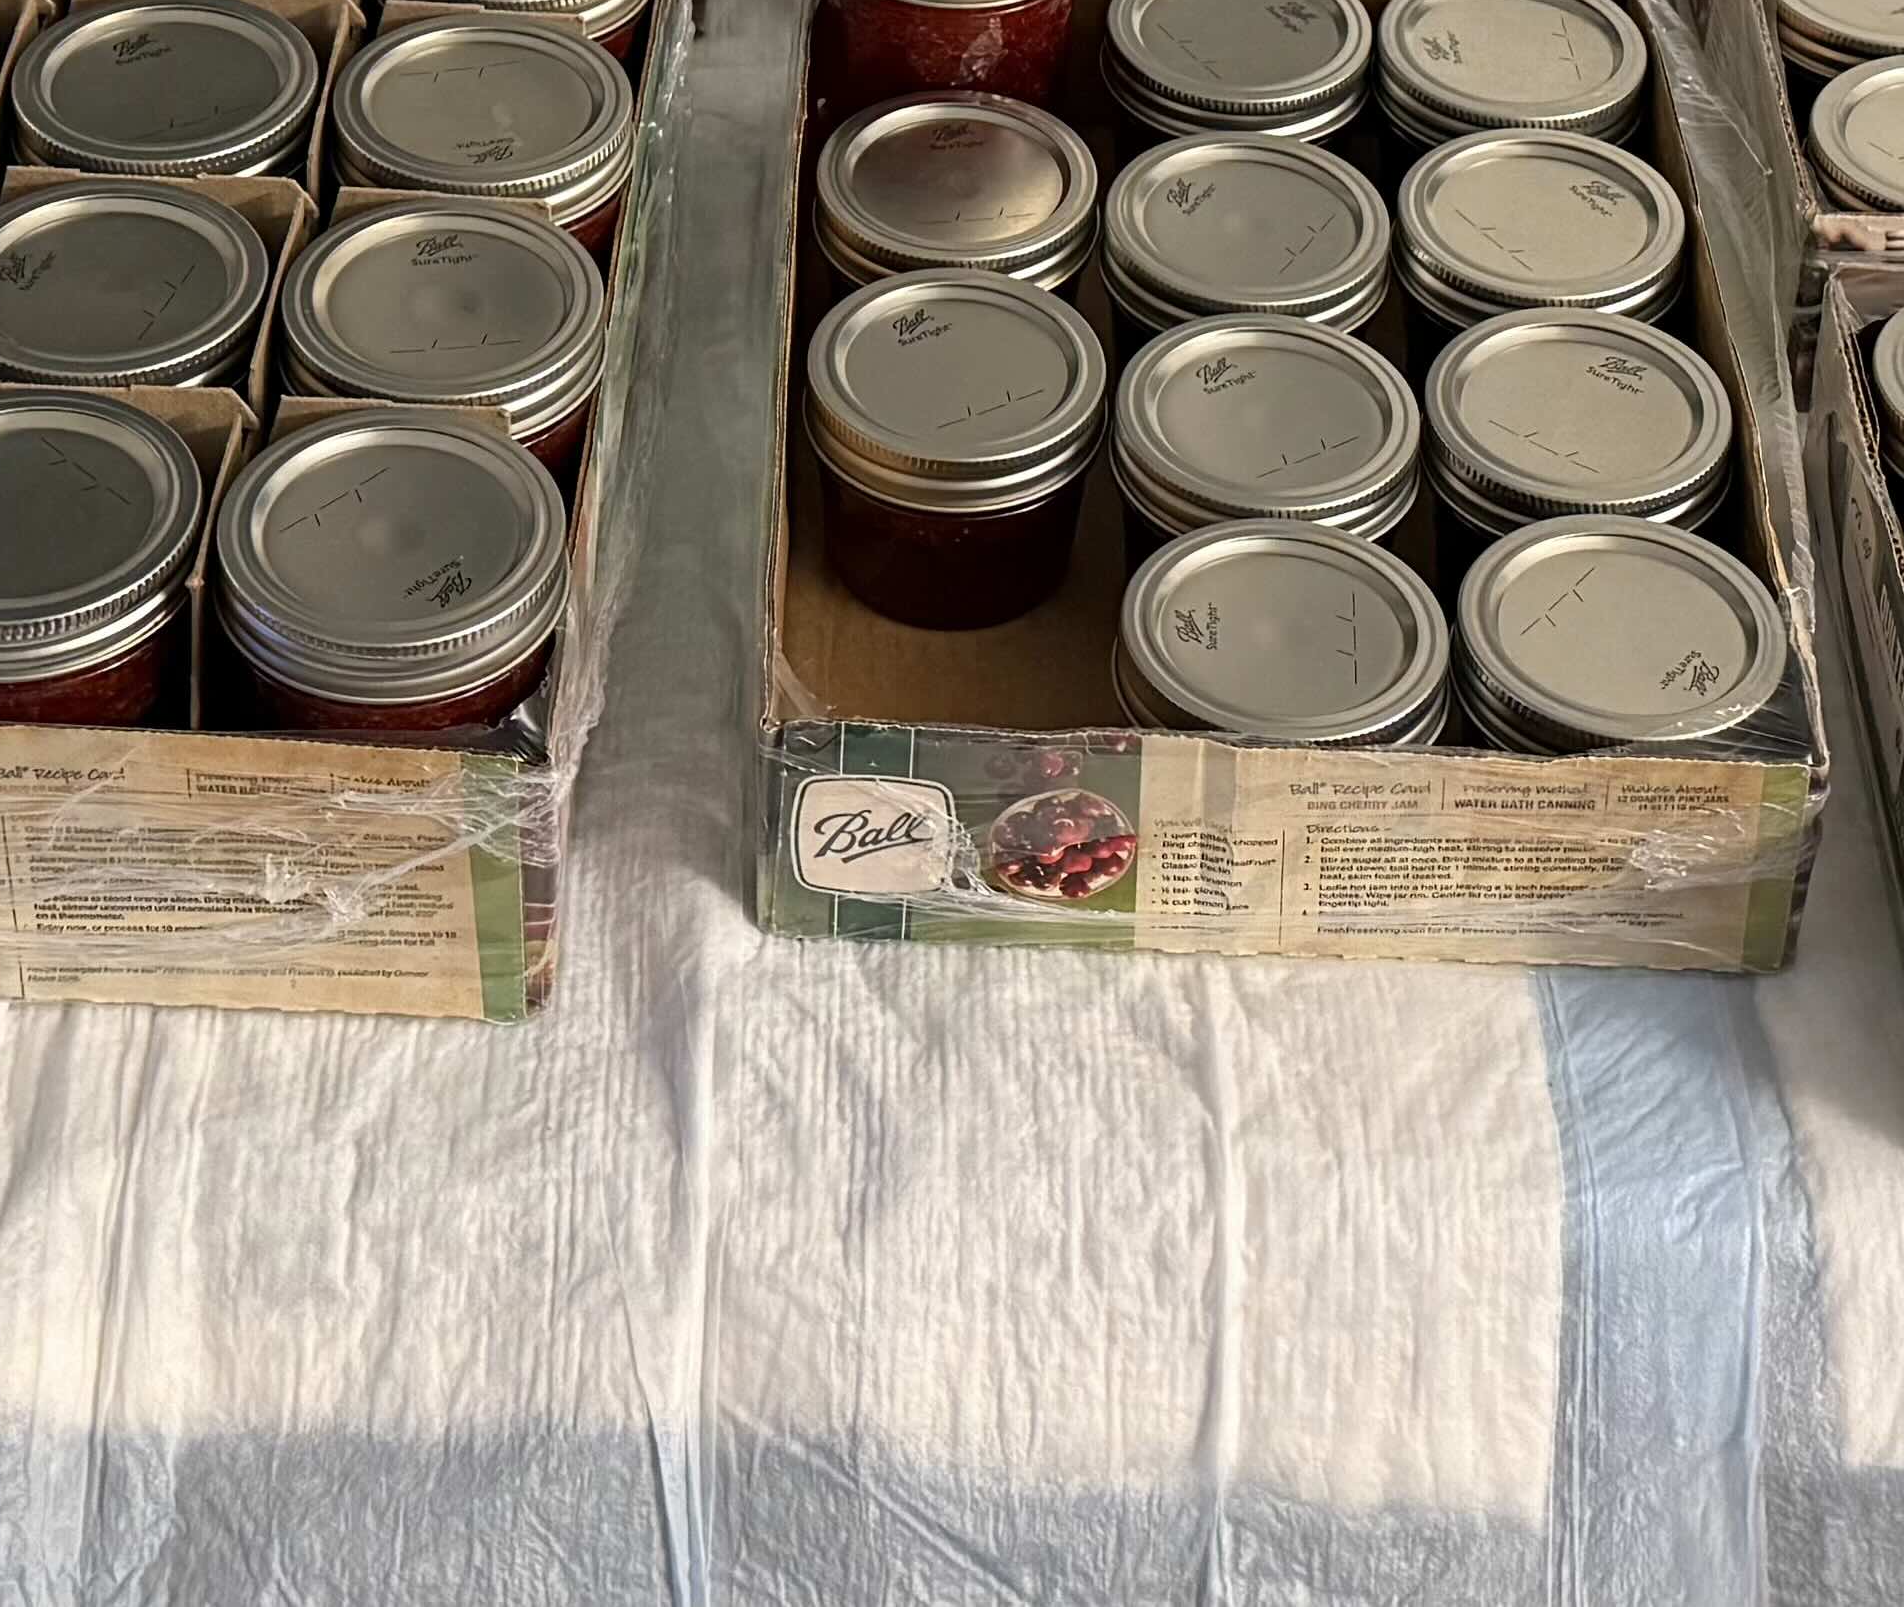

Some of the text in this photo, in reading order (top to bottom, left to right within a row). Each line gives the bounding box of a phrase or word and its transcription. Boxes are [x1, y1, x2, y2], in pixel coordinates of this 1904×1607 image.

[416, 234, 464, 257] Ball
[892, 309, 934, 336] Ball
[1196, 358, 1237, 385] Ball
[1596, 355, 1649, 379] Ball
[1176, 609, 1203, 645] Ball
[32, 768, 84, 784] Recipe
[1331, 780, 1432, 799] Recipe Card
[1453, 799, 1498, 810] WATER
[1537, 799, 1596, 811] CANNING
[814, 810, 934, 864] Ball
[1306, 823, 1380, 835] Directions
[1384, 836, 1444, 847] ingredients
